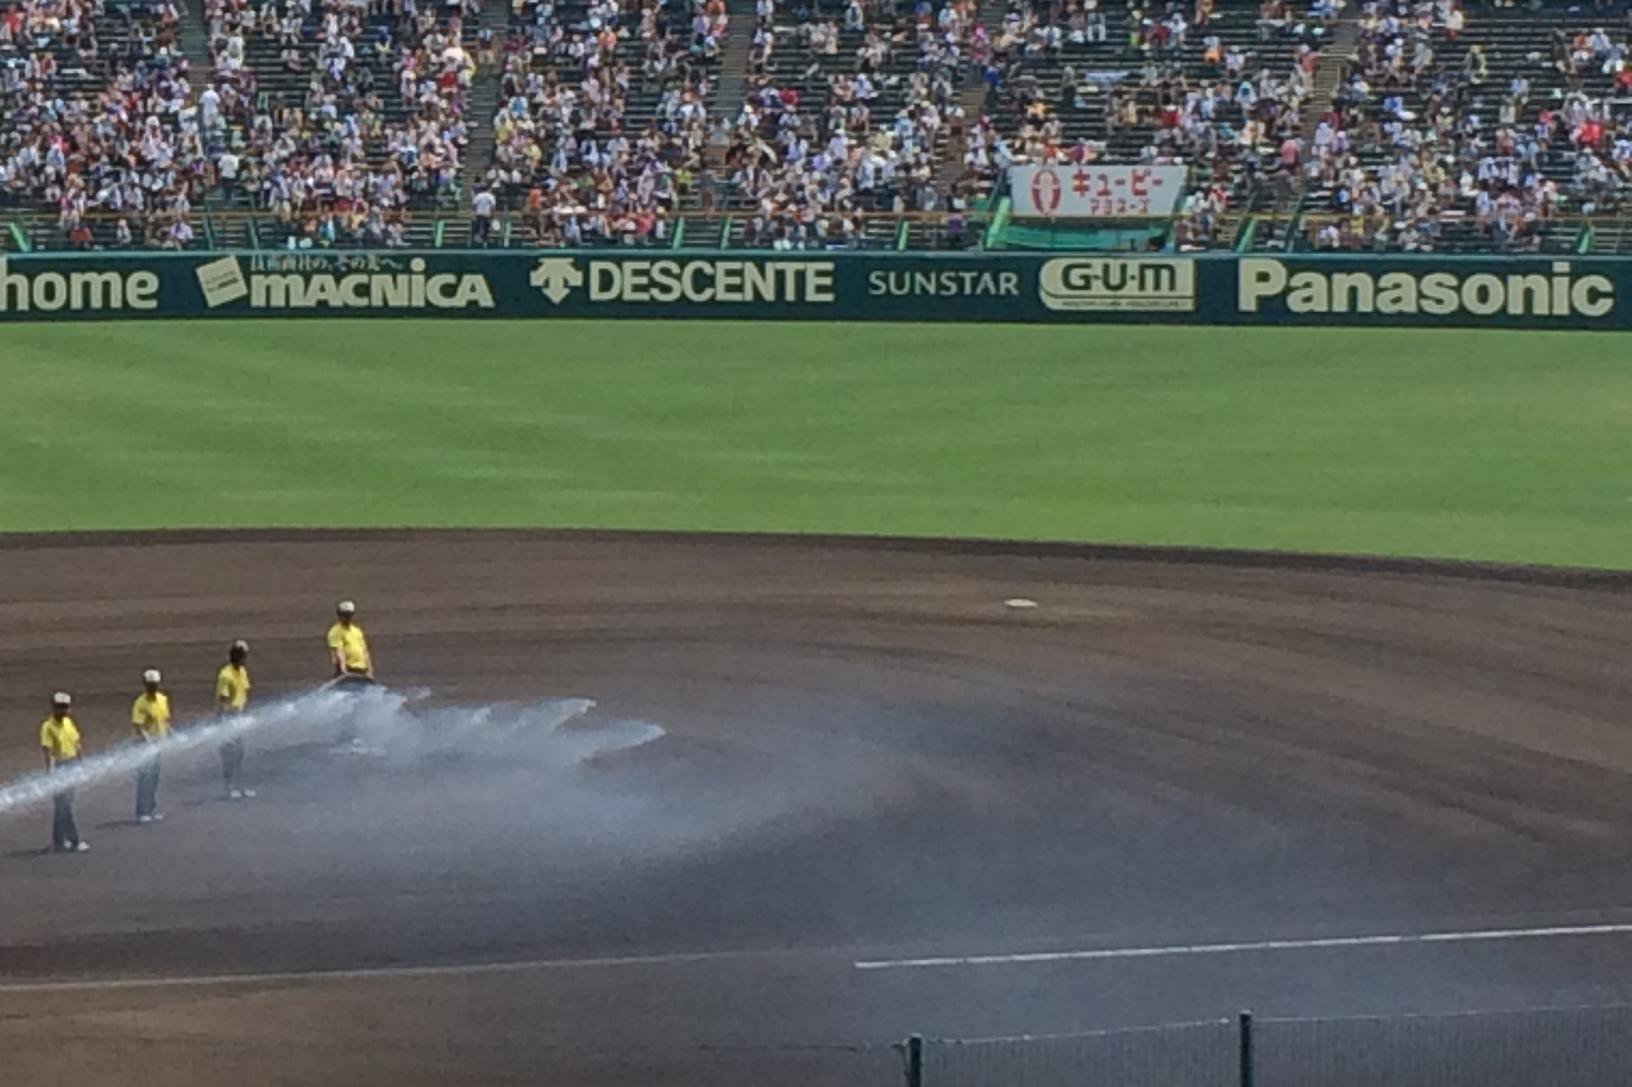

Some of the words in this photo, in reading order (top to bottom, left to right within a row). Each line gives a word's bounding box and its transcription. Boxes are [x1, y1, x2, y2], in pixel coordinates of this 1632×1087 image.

[590, 261, 834, 301] DESCENTE
[869, 270, 1019, 297] SUNSTAR
[1239, 260, 1614, 316] Panasonic
